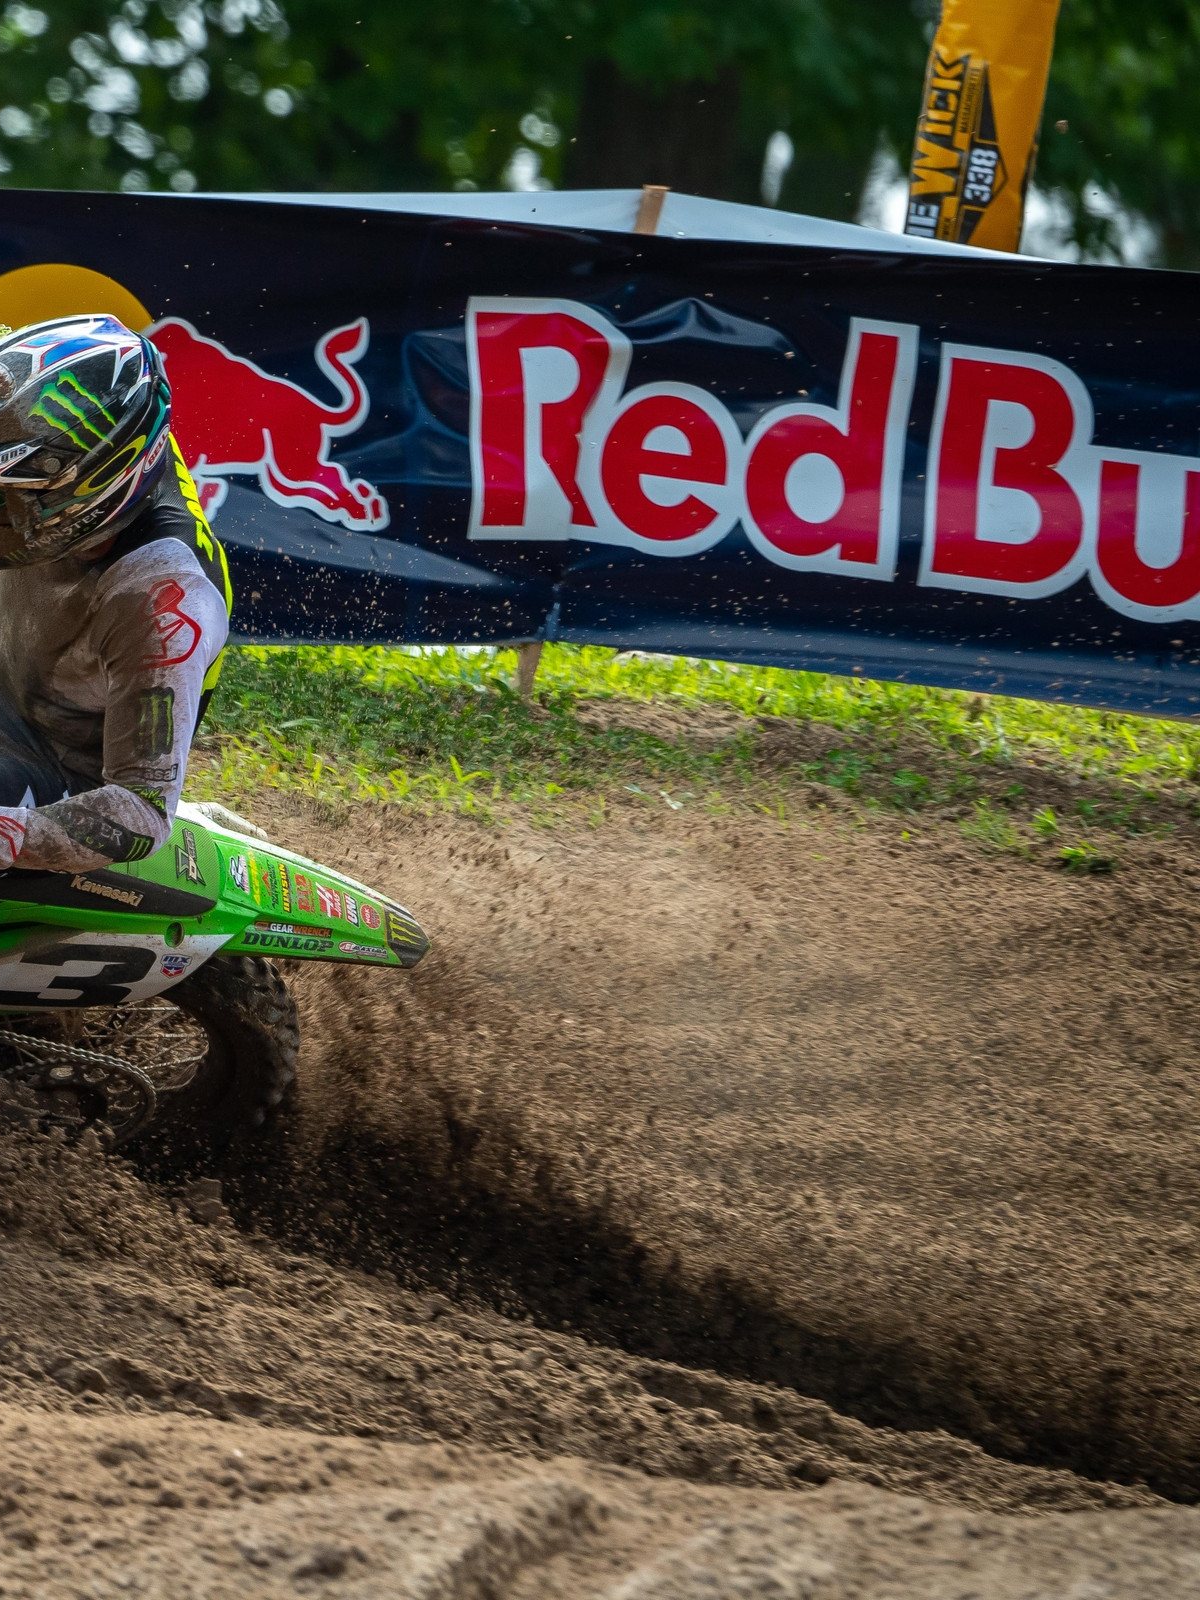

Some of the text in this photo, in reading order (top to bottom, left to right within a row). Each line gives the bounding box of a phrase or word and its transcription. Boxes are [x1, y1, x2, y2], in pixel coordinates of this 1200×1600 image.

[963, 147, 998, 202] 338
[148, 434, 168, 465] BELL
[474, 311, 901, 565] Red
[24, 507, 106, 551] MONSTER
[70, 874, 144, 907] Kawasaki
[278, 863, 291, 913] HINSON
[241, 931, 335, 952] DUNLOP
